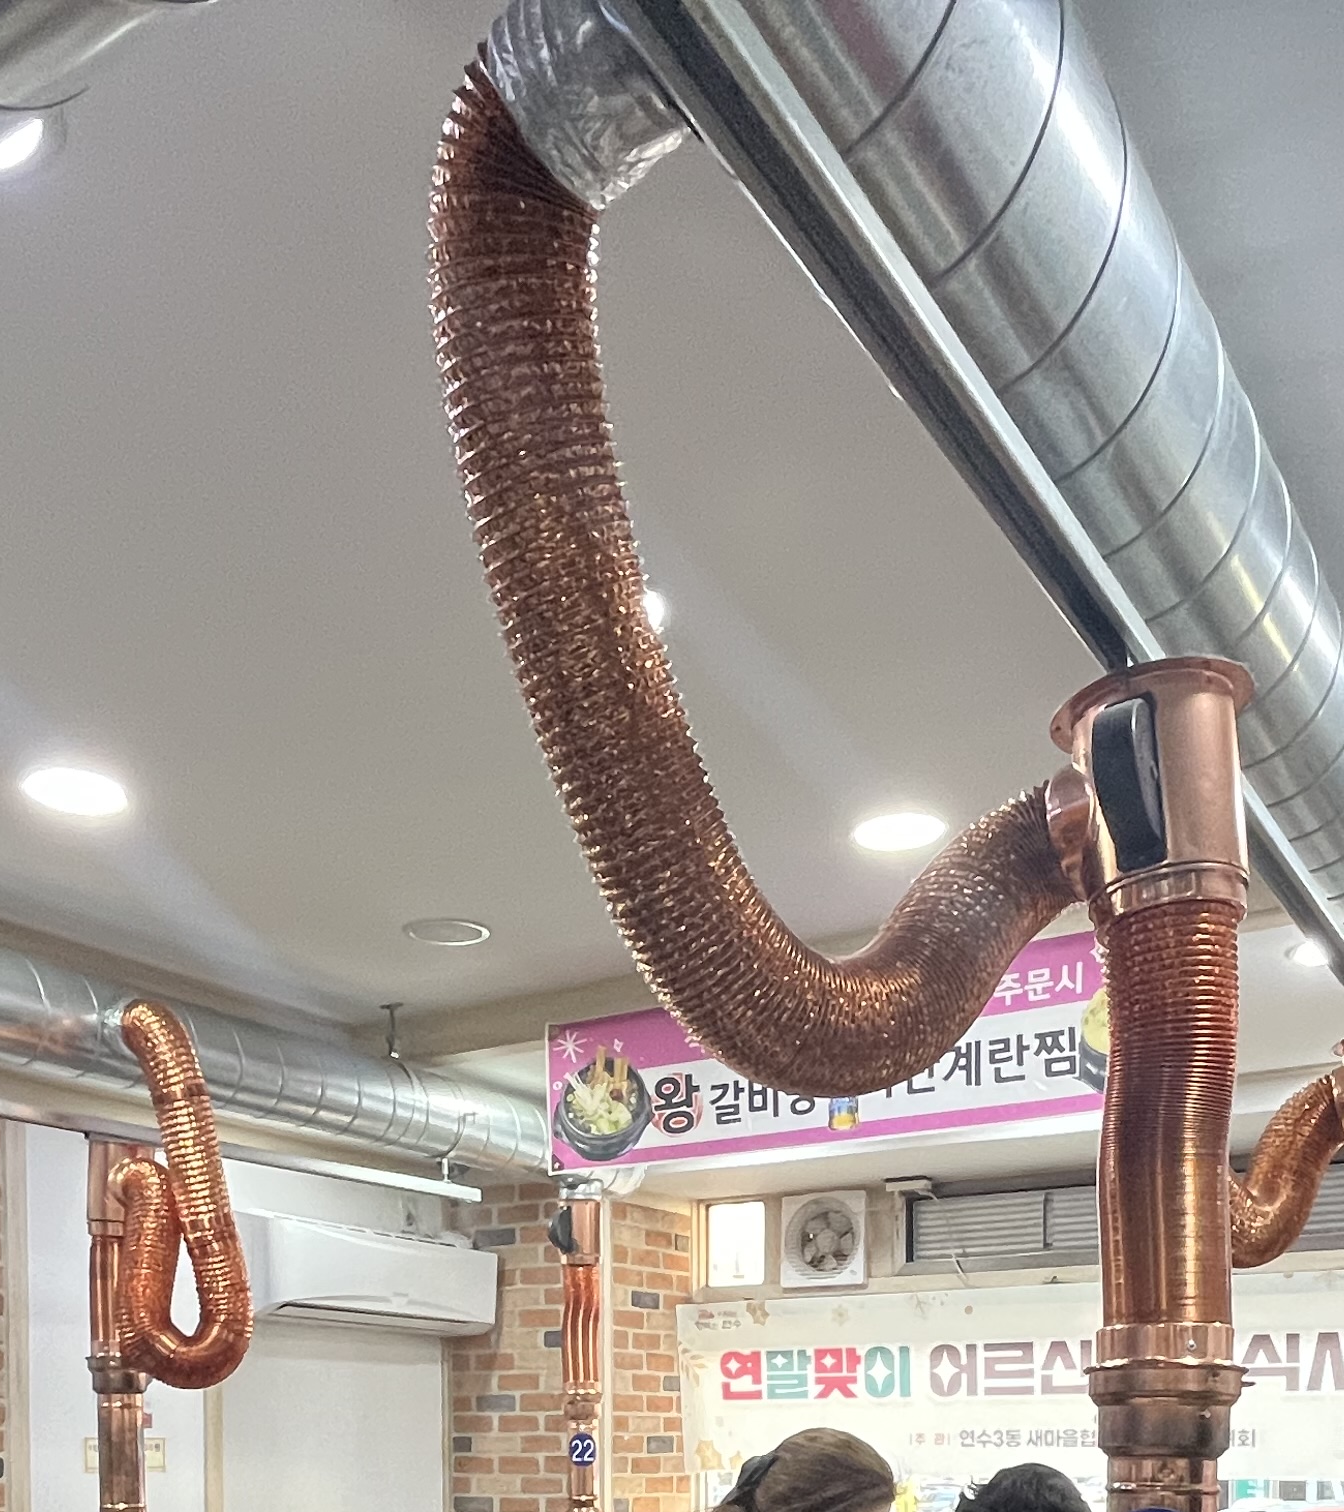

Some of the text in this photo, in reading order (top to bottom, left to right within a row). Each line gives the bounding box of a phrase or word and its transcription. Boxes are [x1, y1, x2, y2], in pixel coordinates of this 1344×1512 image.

[721, 1345, 912, 1400] 연말맞이
[929, 1340, 1093, 1397] 어르신
[570, 1438, 595, 1462] 22
[959, 1429, 1022, 1448] 연수3동
